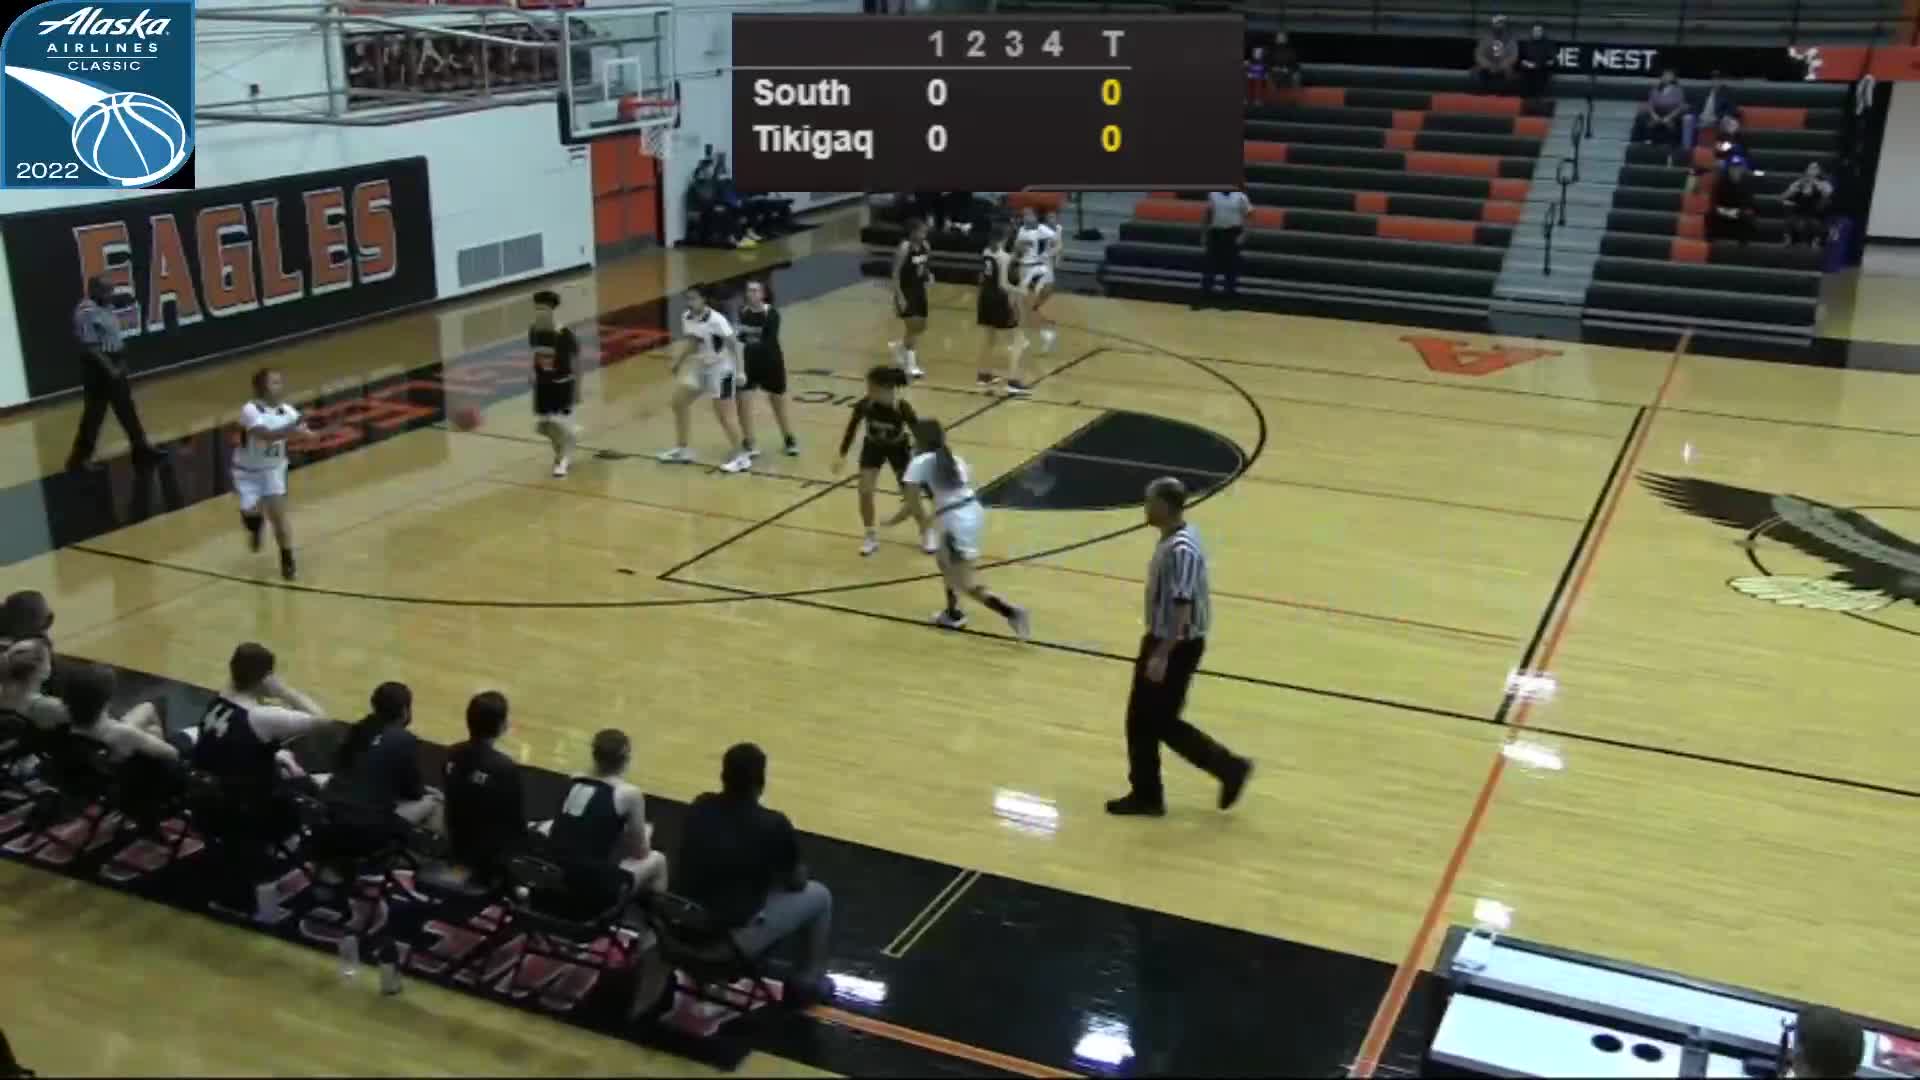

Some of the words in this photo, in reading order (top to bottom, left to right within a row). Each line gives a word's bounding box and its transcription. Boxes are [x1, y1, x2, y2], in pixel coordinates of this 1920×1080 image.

[1556, 47, 1580, 67] HE
[1592, 49, 1657, 70] NEST
[73, 179, 398, 338] EAGLES
